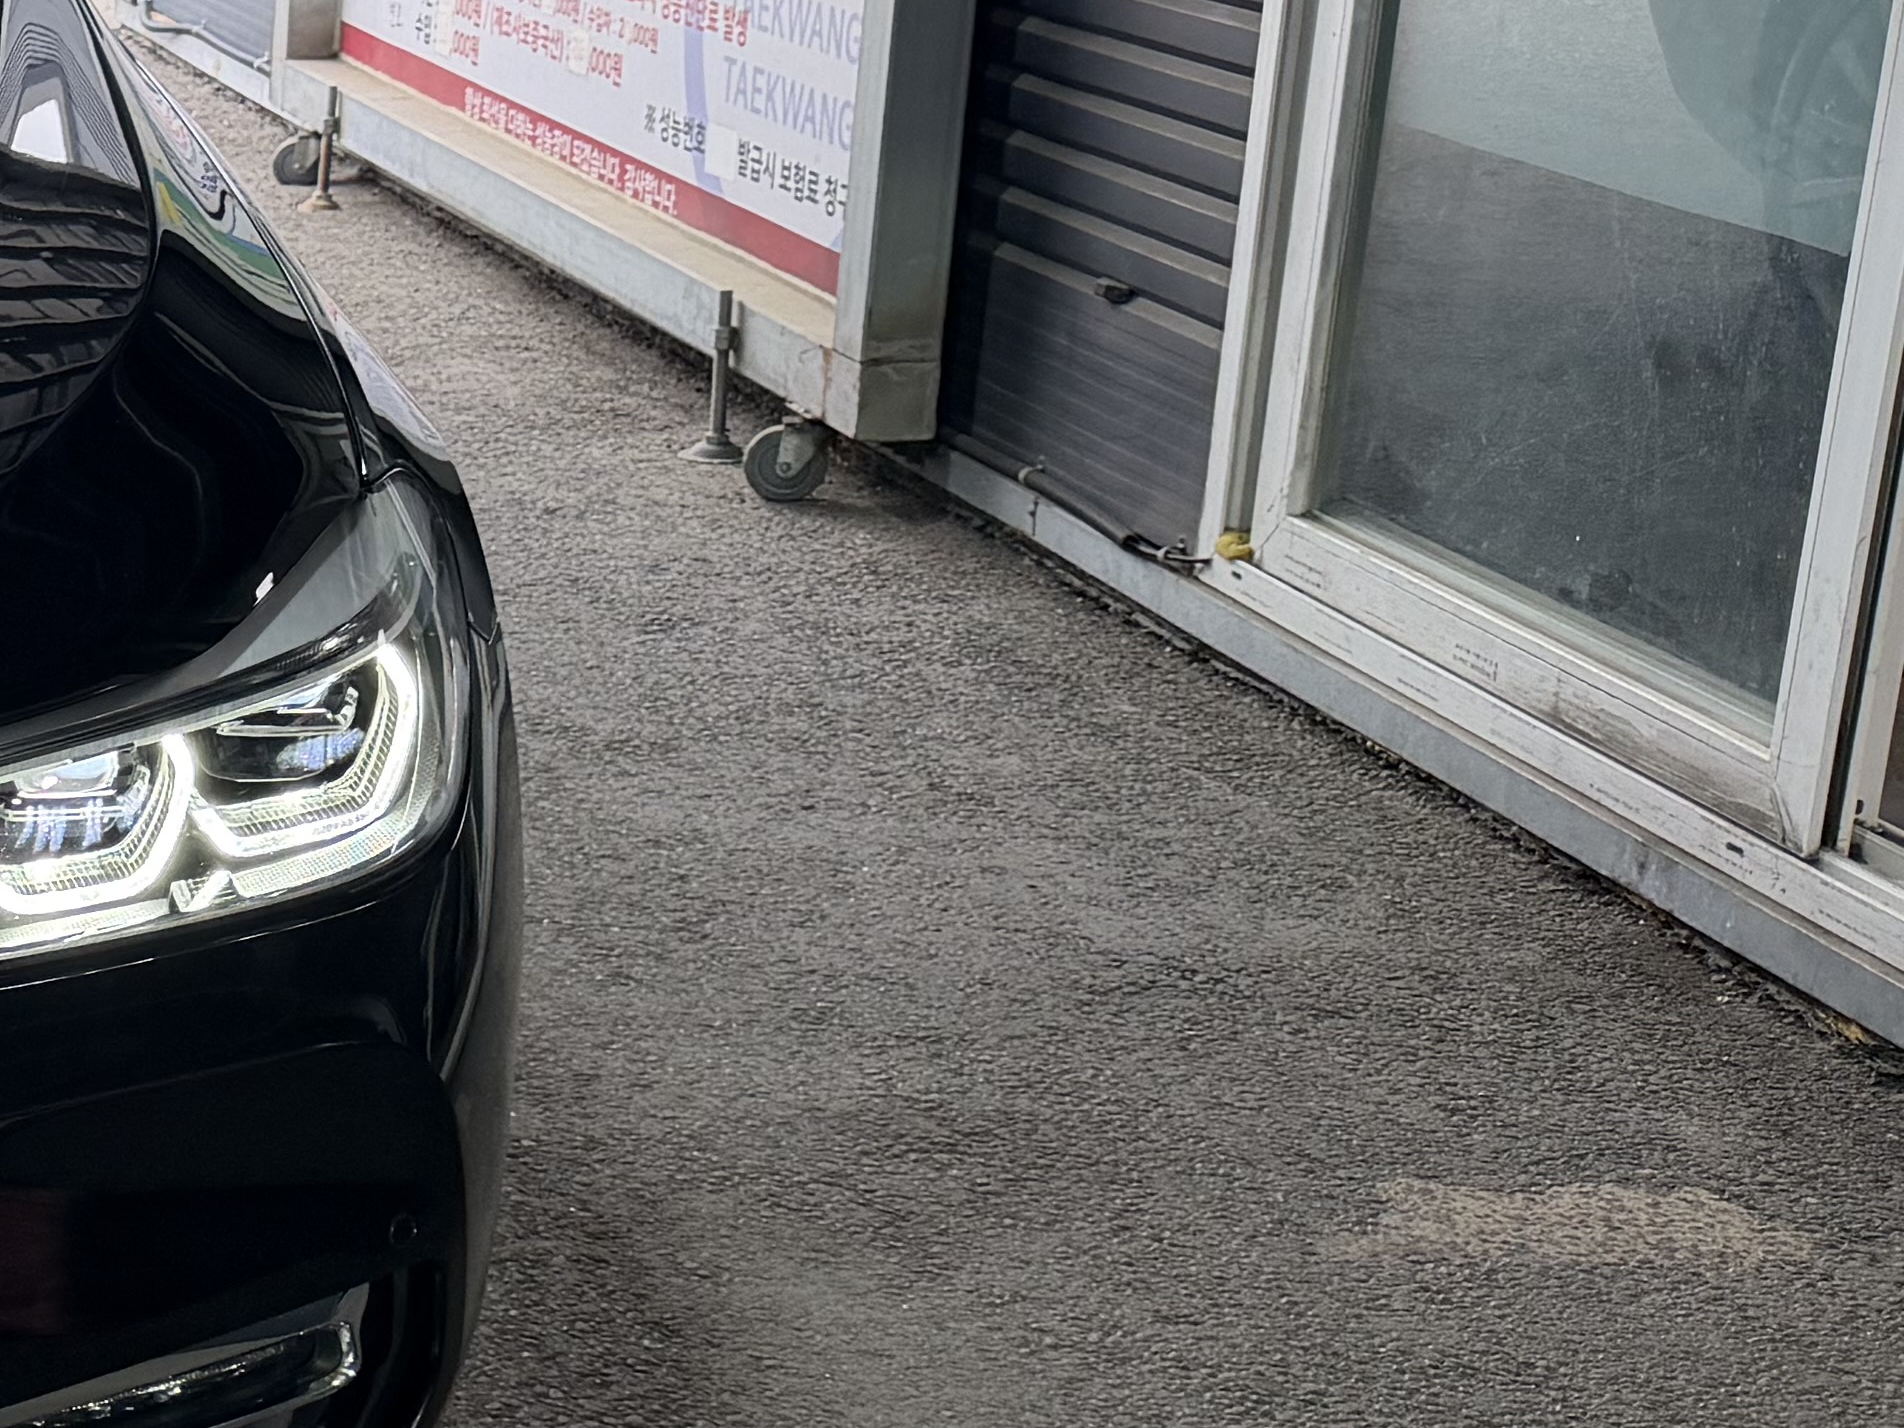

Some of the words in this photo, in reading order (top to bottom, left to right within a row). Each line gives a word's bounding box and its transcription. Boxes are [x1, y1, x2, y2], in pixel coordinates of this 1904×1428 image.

[721, 2, 749, 49] 발생
[723, 56, 855, 153] TAEKWANG
[624, 163, 678, 215] 감사합니다.
[657, 104, 707, 160] 성능번호
[735, 136, 777, 191] 발급시
[777, 154, 821, 211] 보험료
